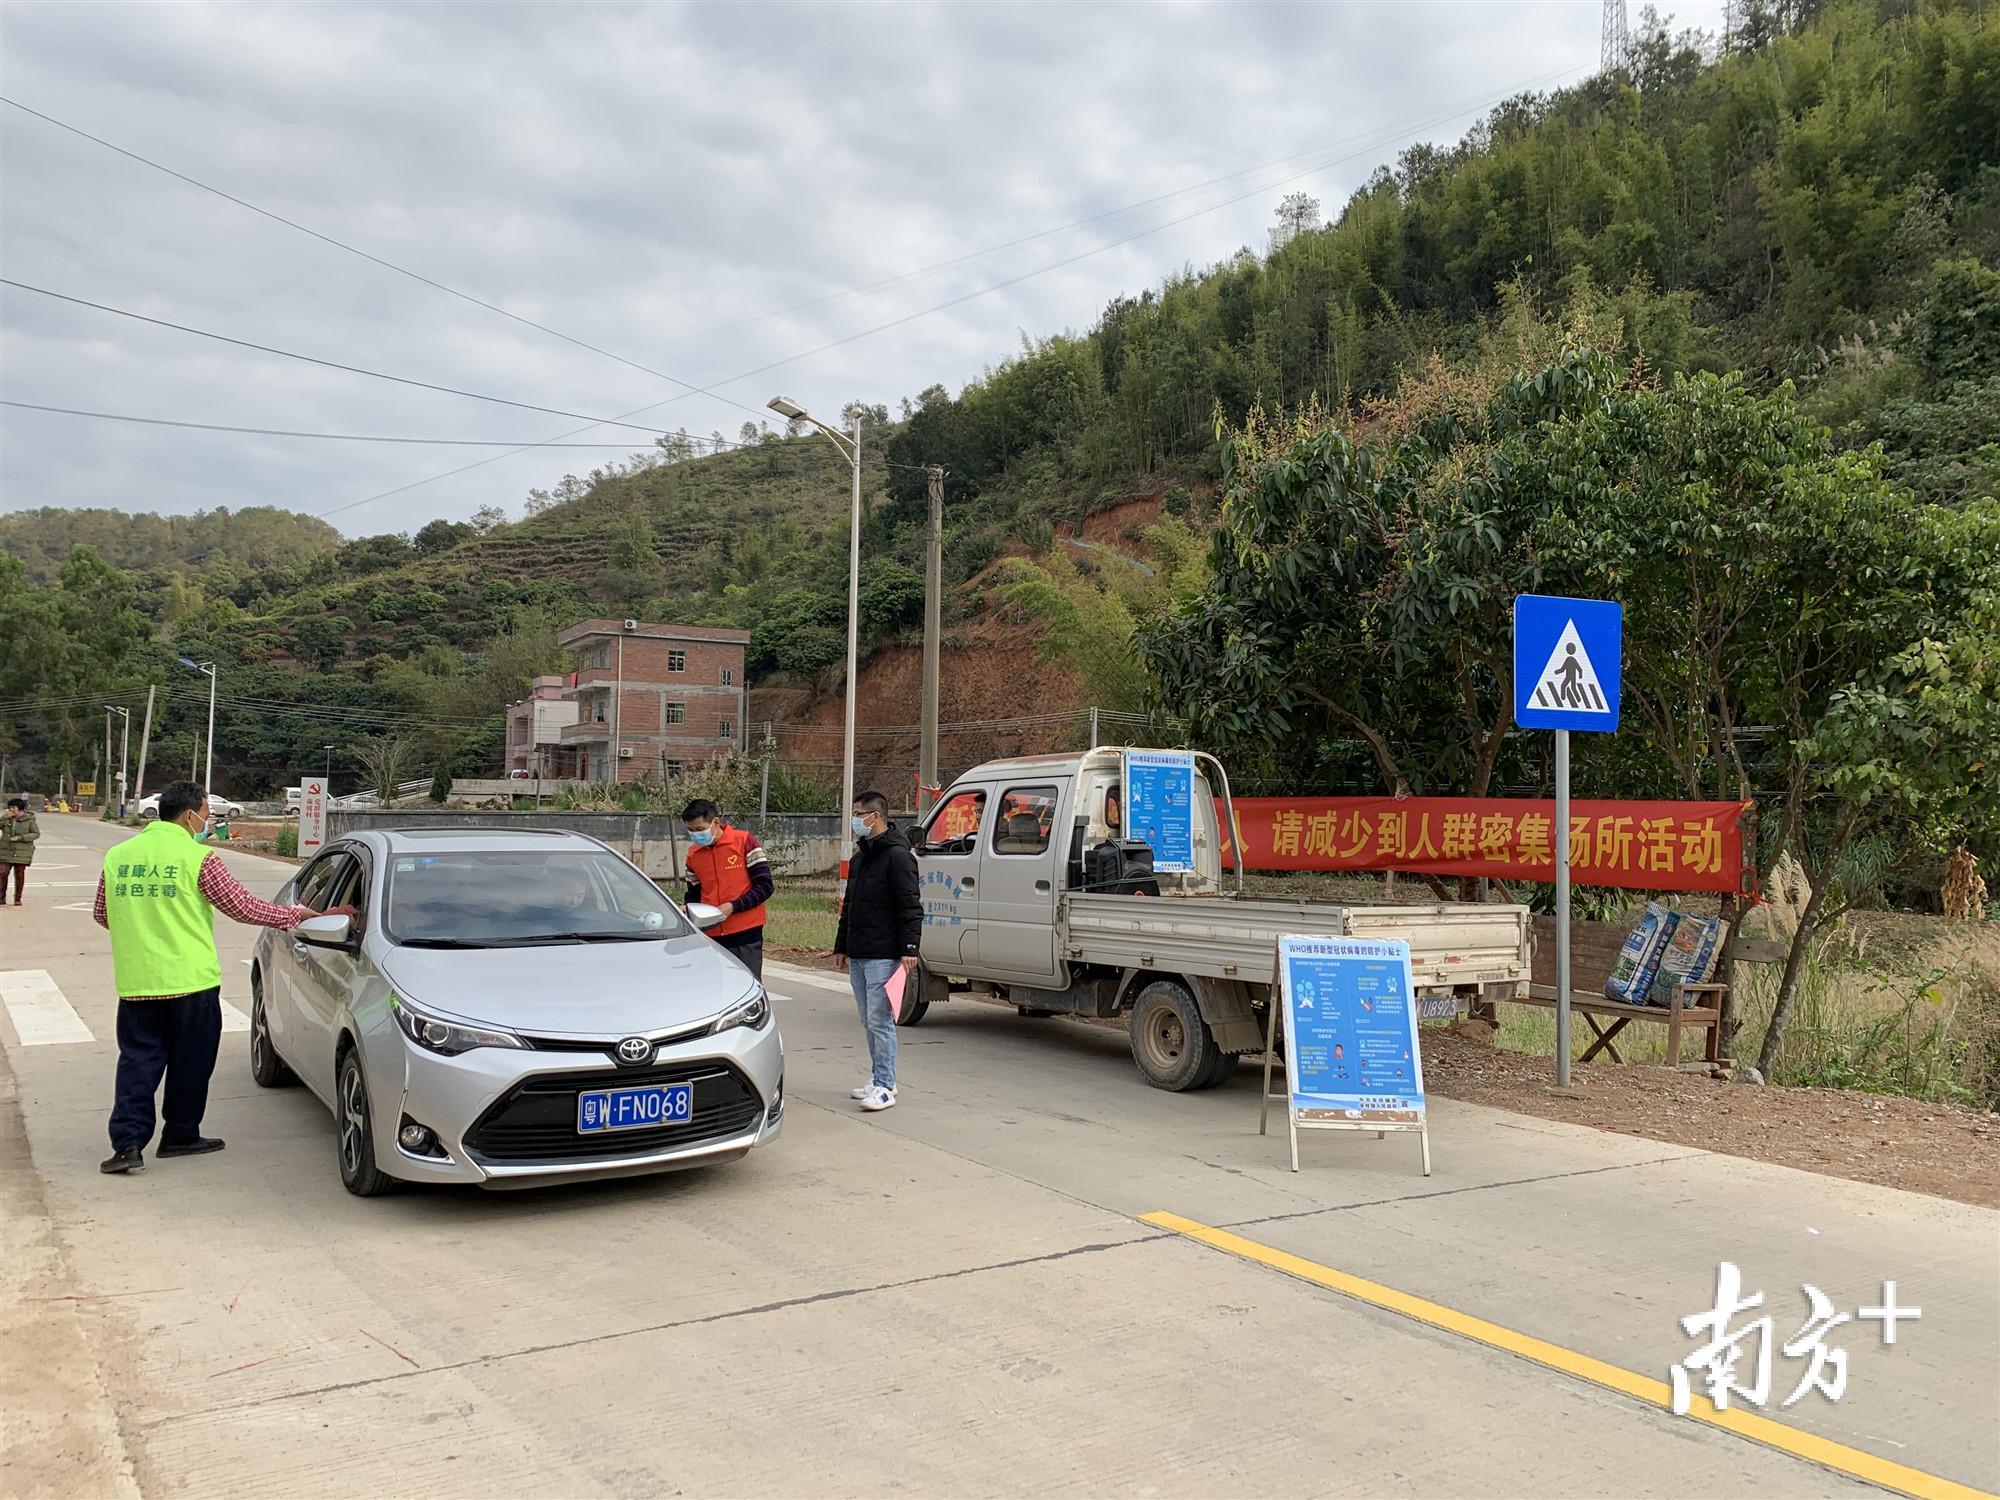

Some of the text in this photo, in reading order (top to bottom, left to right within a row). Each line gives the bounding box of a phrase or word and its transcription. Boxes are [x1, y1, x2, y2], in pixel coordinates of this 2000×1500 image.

[1271, 808, 1722, 873] 请减少到人群密集场所活动
[117, 864, 179, 879] 健康人生
[115, 883, 177, 898] 绿色无毒
[1289, 944, 1401, 957] WHO推荐新型冠状病毒的防护小贴士
